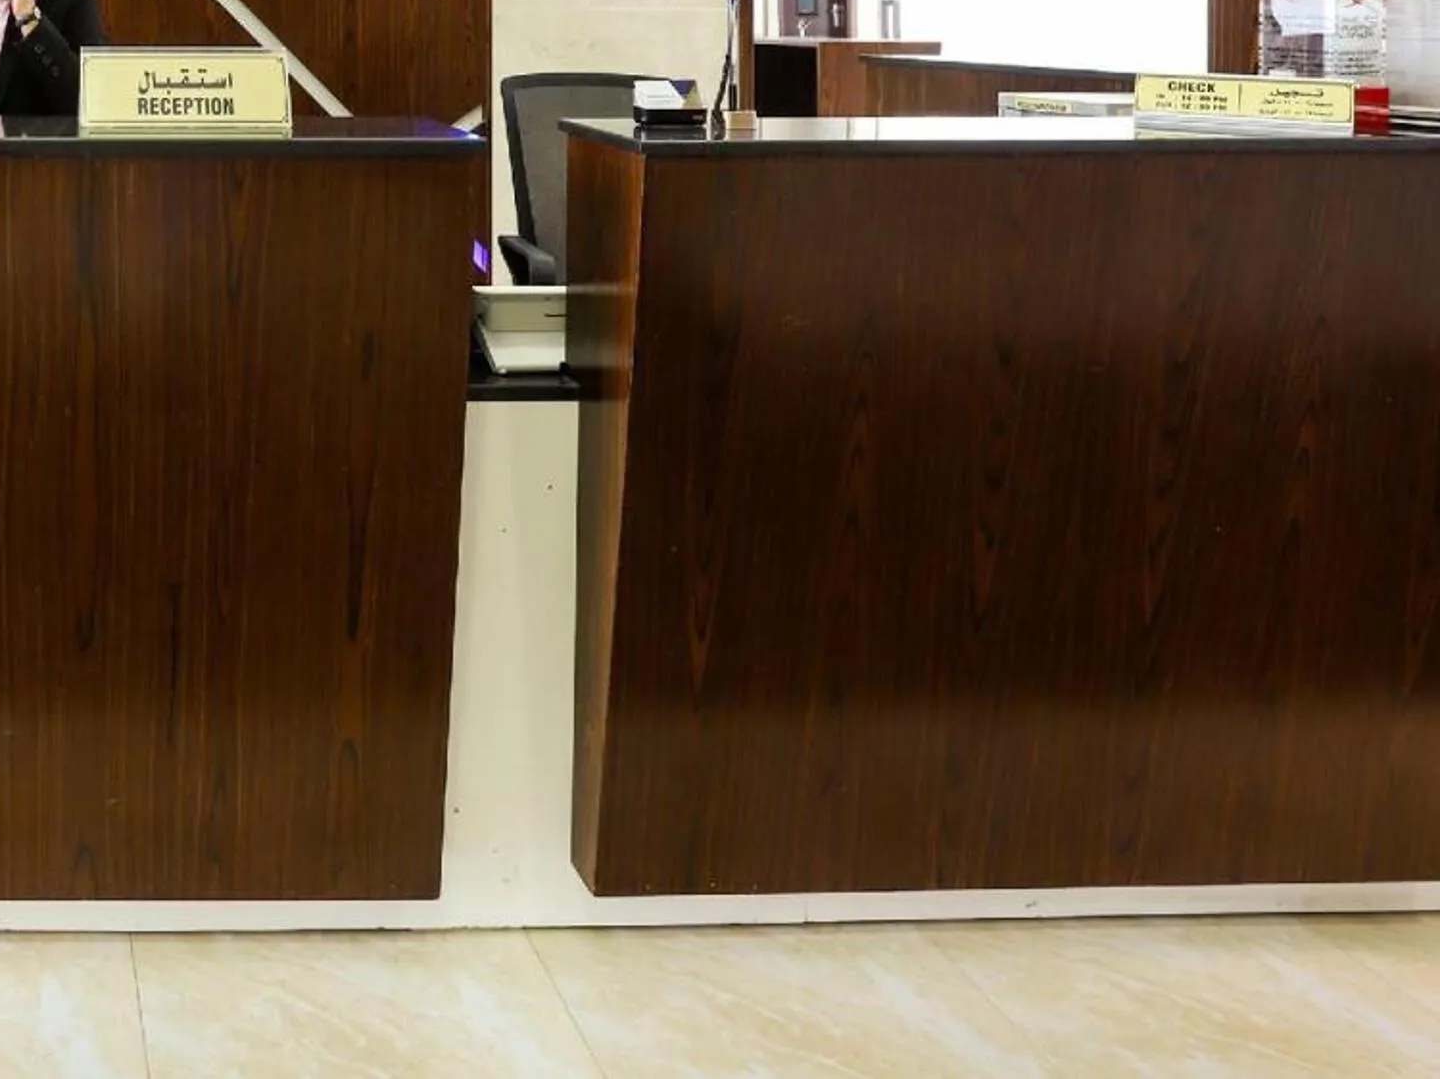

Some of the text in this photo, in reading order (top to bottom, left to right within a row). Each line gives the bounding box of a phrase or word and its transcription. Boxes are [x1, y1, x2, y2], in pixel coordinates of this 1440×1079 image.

[138, 68, 233, 94] استقبال
[1168, 80, 1216, 92] CHECK
[137, 97, 235, 116] RECEPTION
